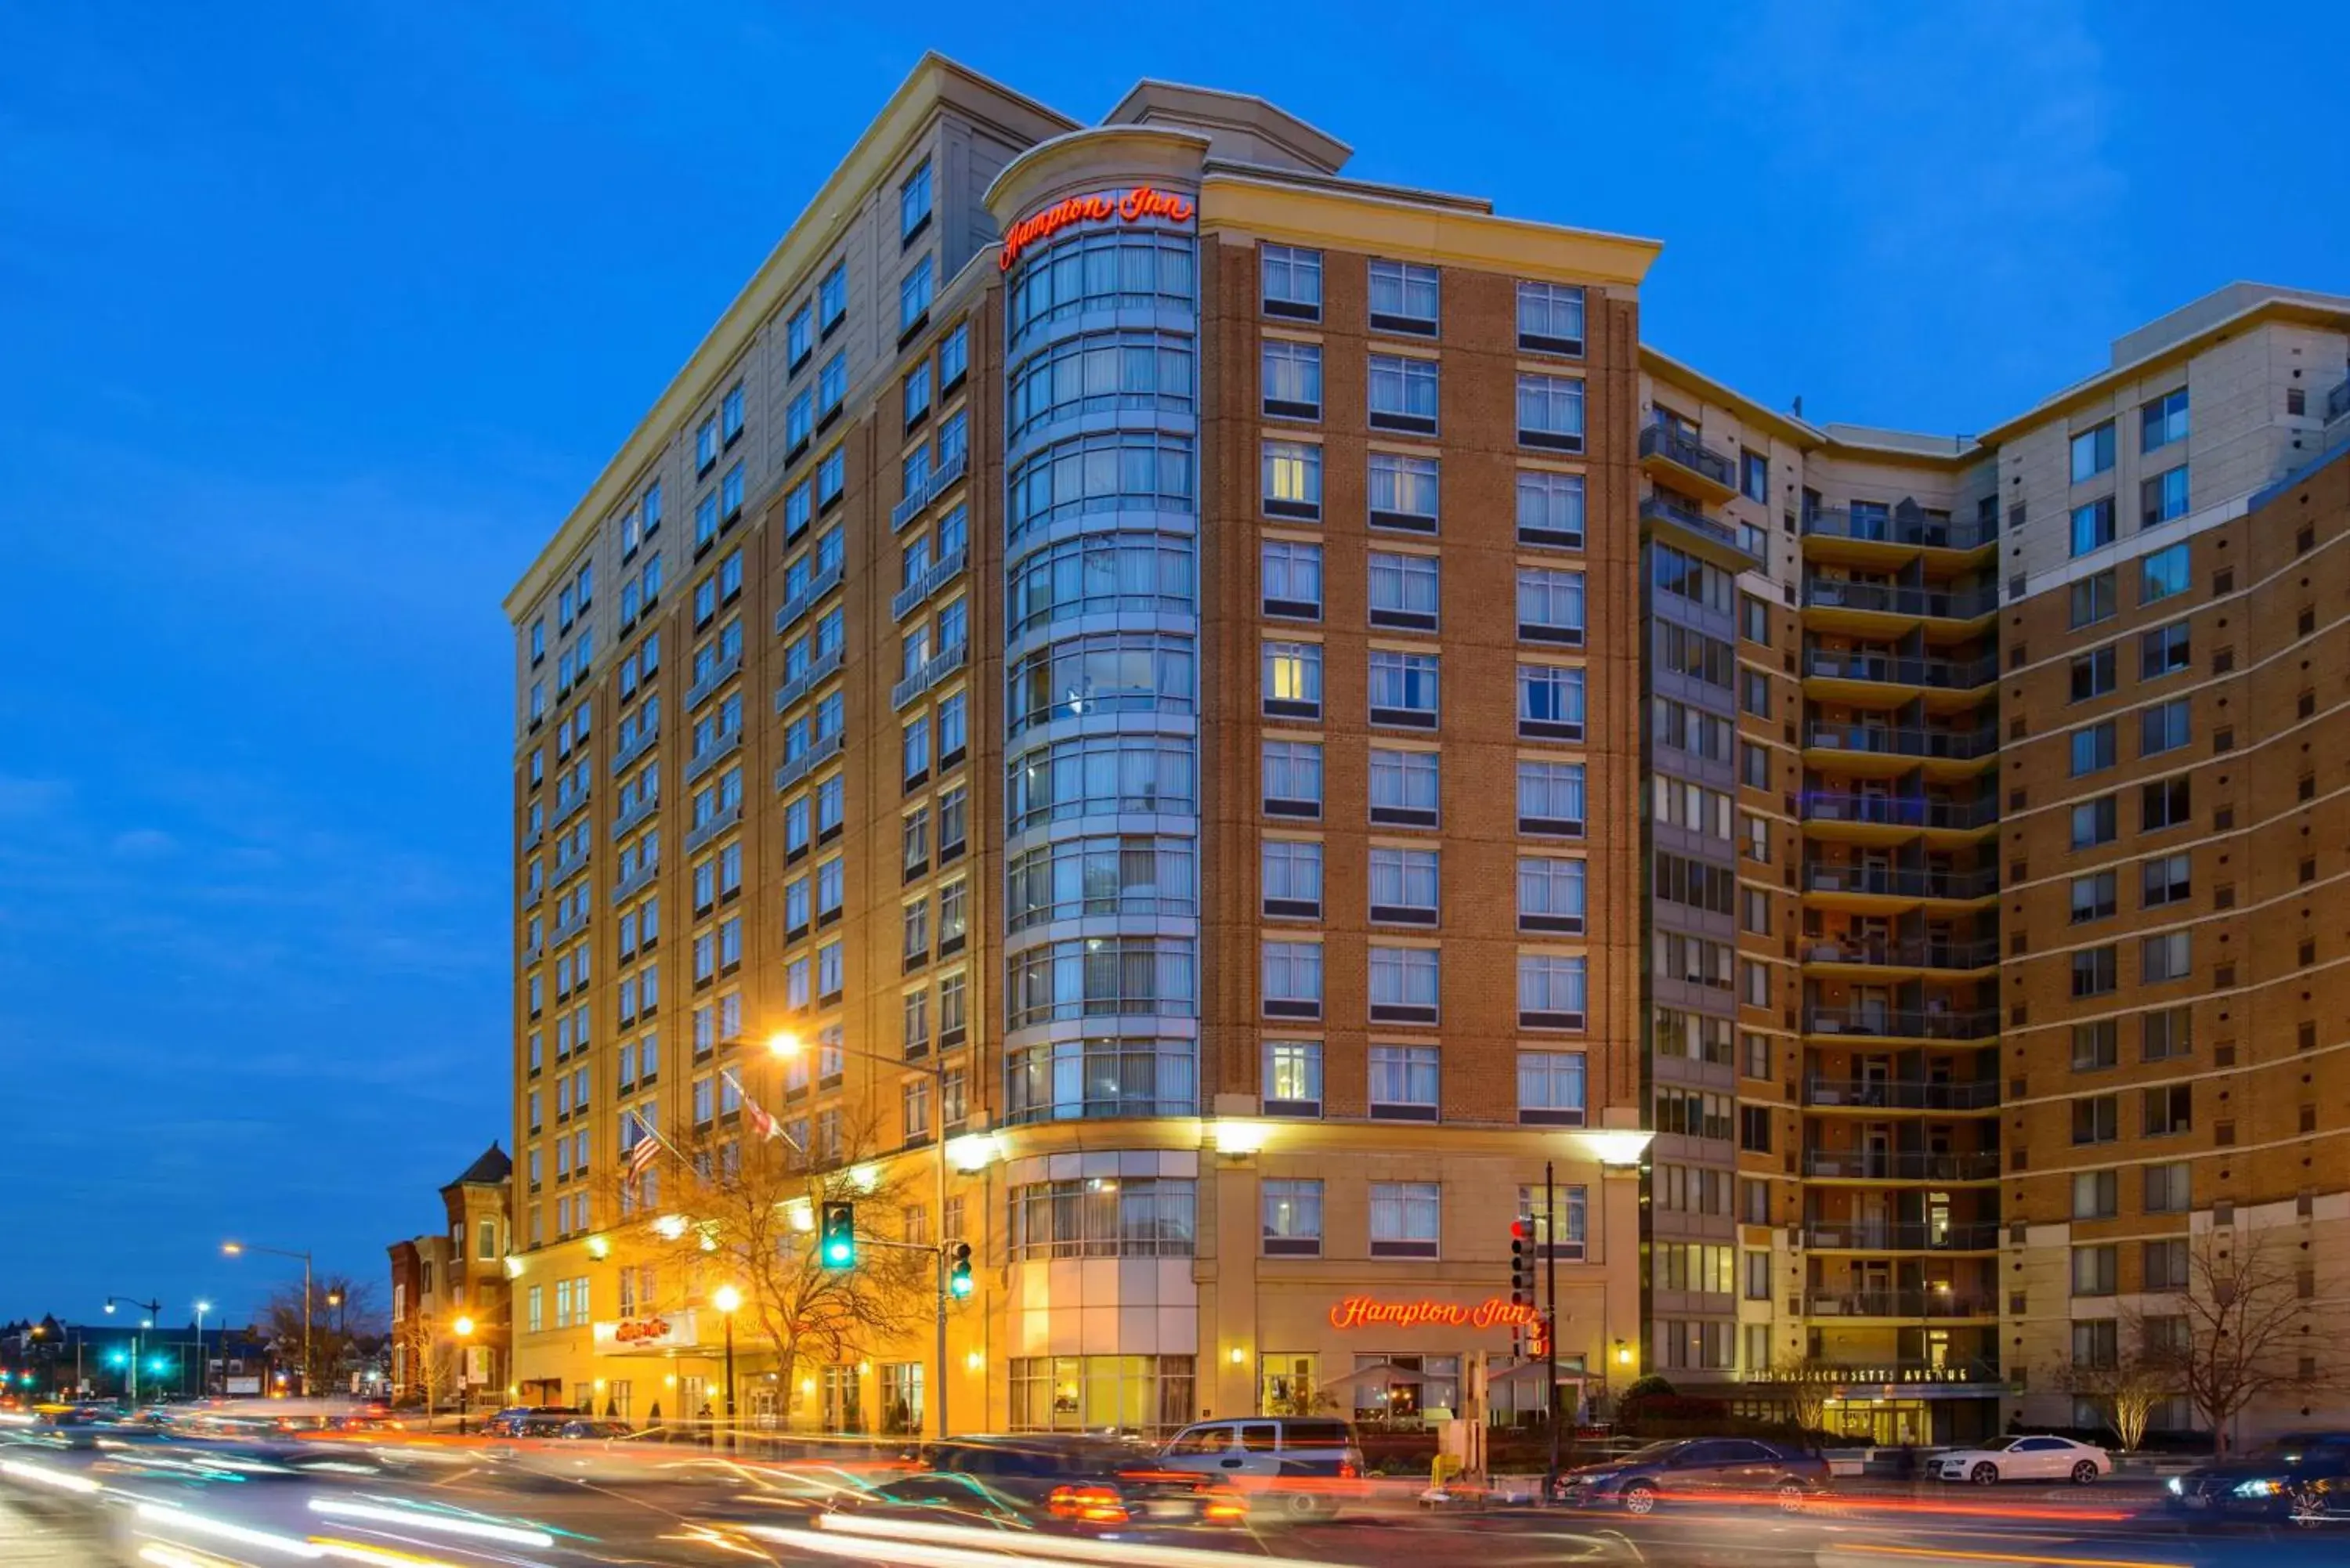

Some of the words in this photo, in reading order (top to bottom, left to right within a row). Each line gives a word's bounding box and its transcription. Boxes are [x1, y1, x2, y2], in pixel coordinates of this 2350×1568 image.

[1000, 195, 1114, 271] Hampton
[1119, 185, 1193, 222] Inn
[1330, 1295, 1470, 1328] Hampton
[1472, 1295, 1538, 1328] Inn
[1904, 1368, 1967, 1382] AVENUE
